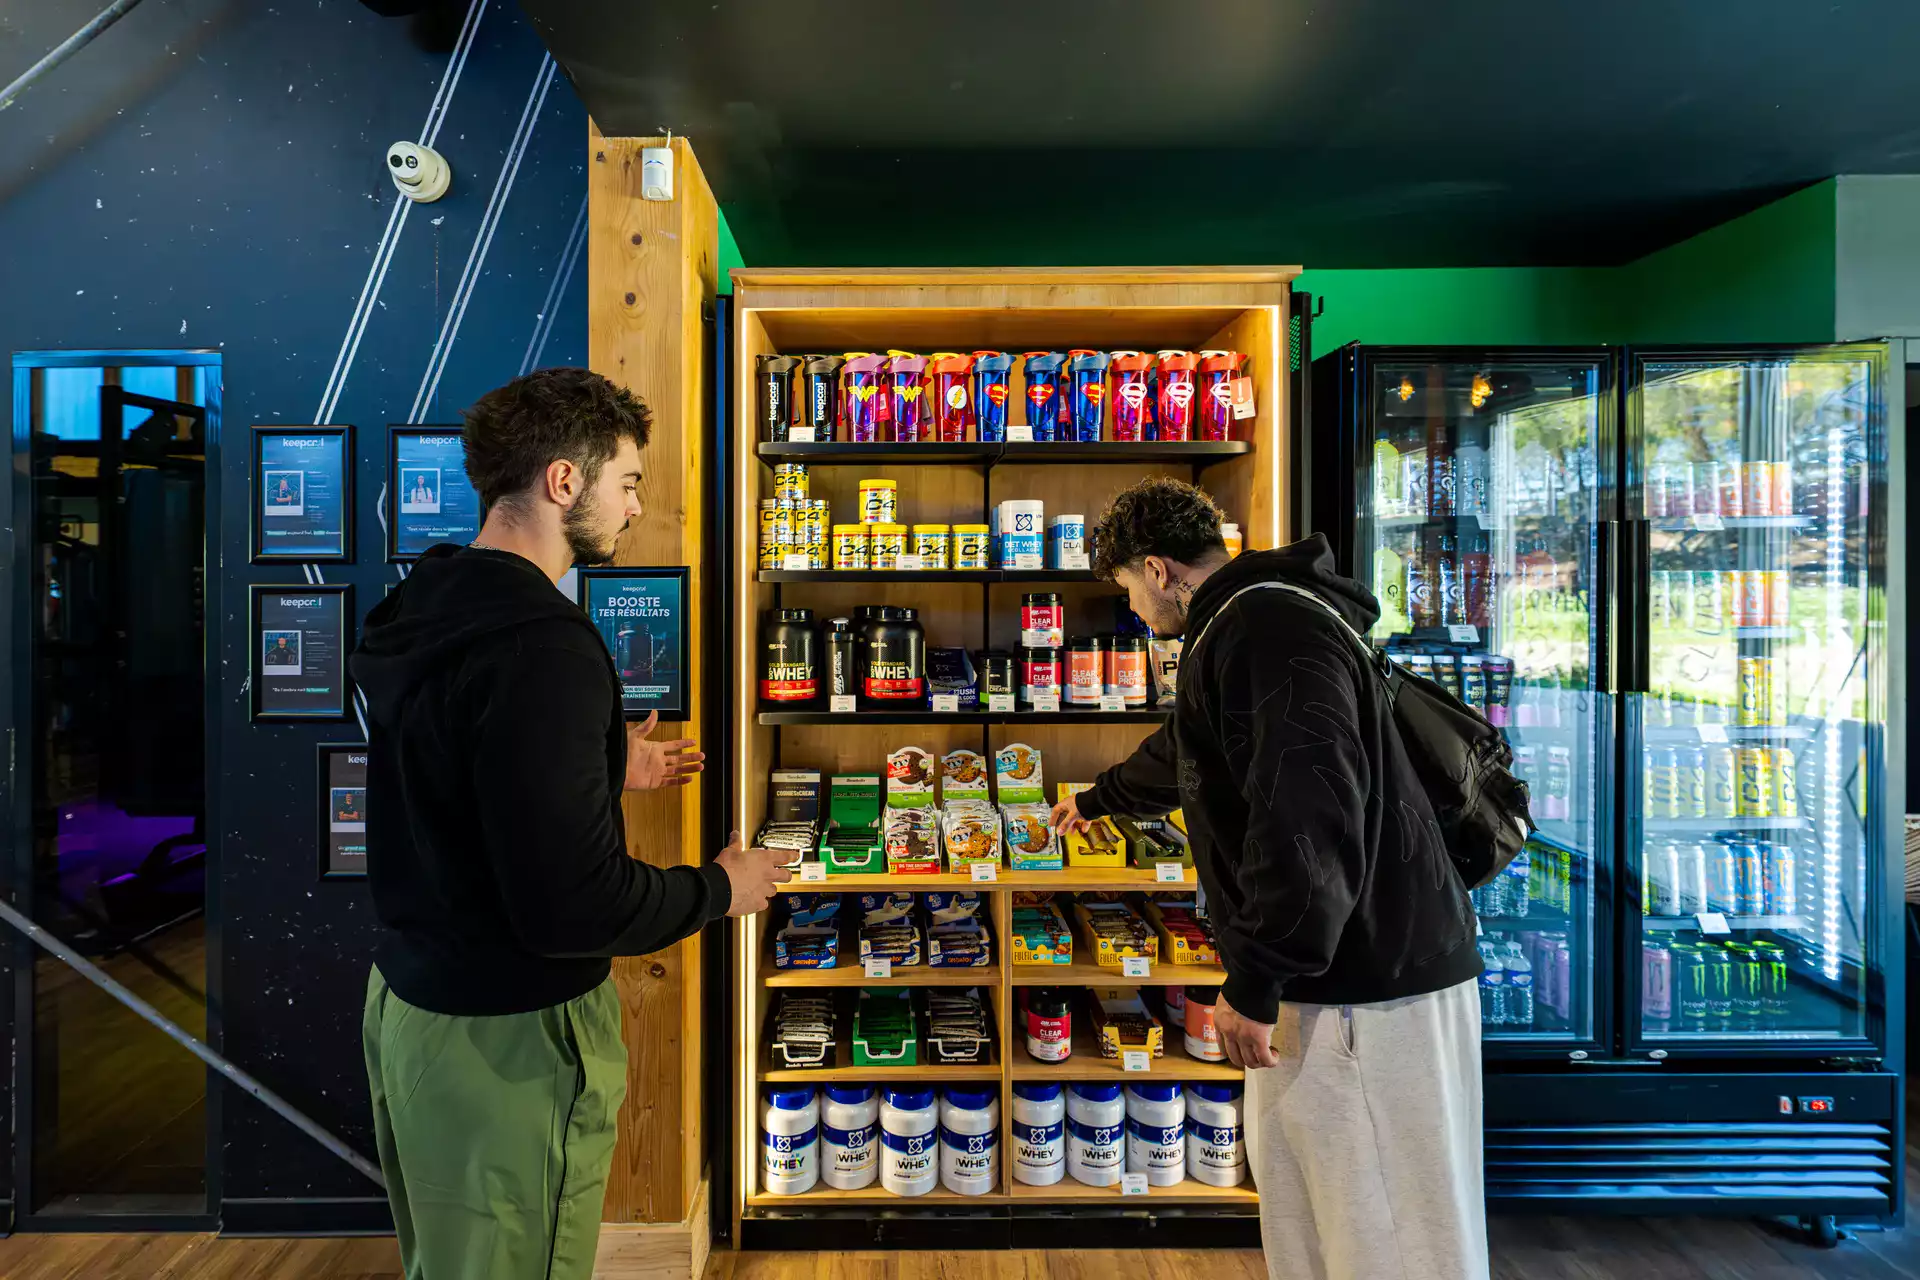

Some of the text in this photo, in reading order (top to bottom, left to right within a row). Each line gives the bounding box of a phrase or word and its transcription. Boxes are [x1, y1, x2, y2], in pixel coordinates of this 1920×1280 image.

[608, 597, 660, 607] BOOSTE
[599, 607, 670, 617] TES RÉSULTATS
[773, 666, 814, 680] WHEY
[875, 666, 914, 679] WHEY
[1014, 952, 1032, 961] FULFIL
[1100, 953, 1118, 963] FULFIL
[1176, 952, 1194, 962] FULFIL
[838, 1149, 872, 1163] WHEY
[1020, 1148, 1054, 1159] WHEY
[1084, 1149, 1118, 1160] WHEY
[898, 1157, 931, 1170] WHEY
[958, 1156, 992, 1168] WHEY
